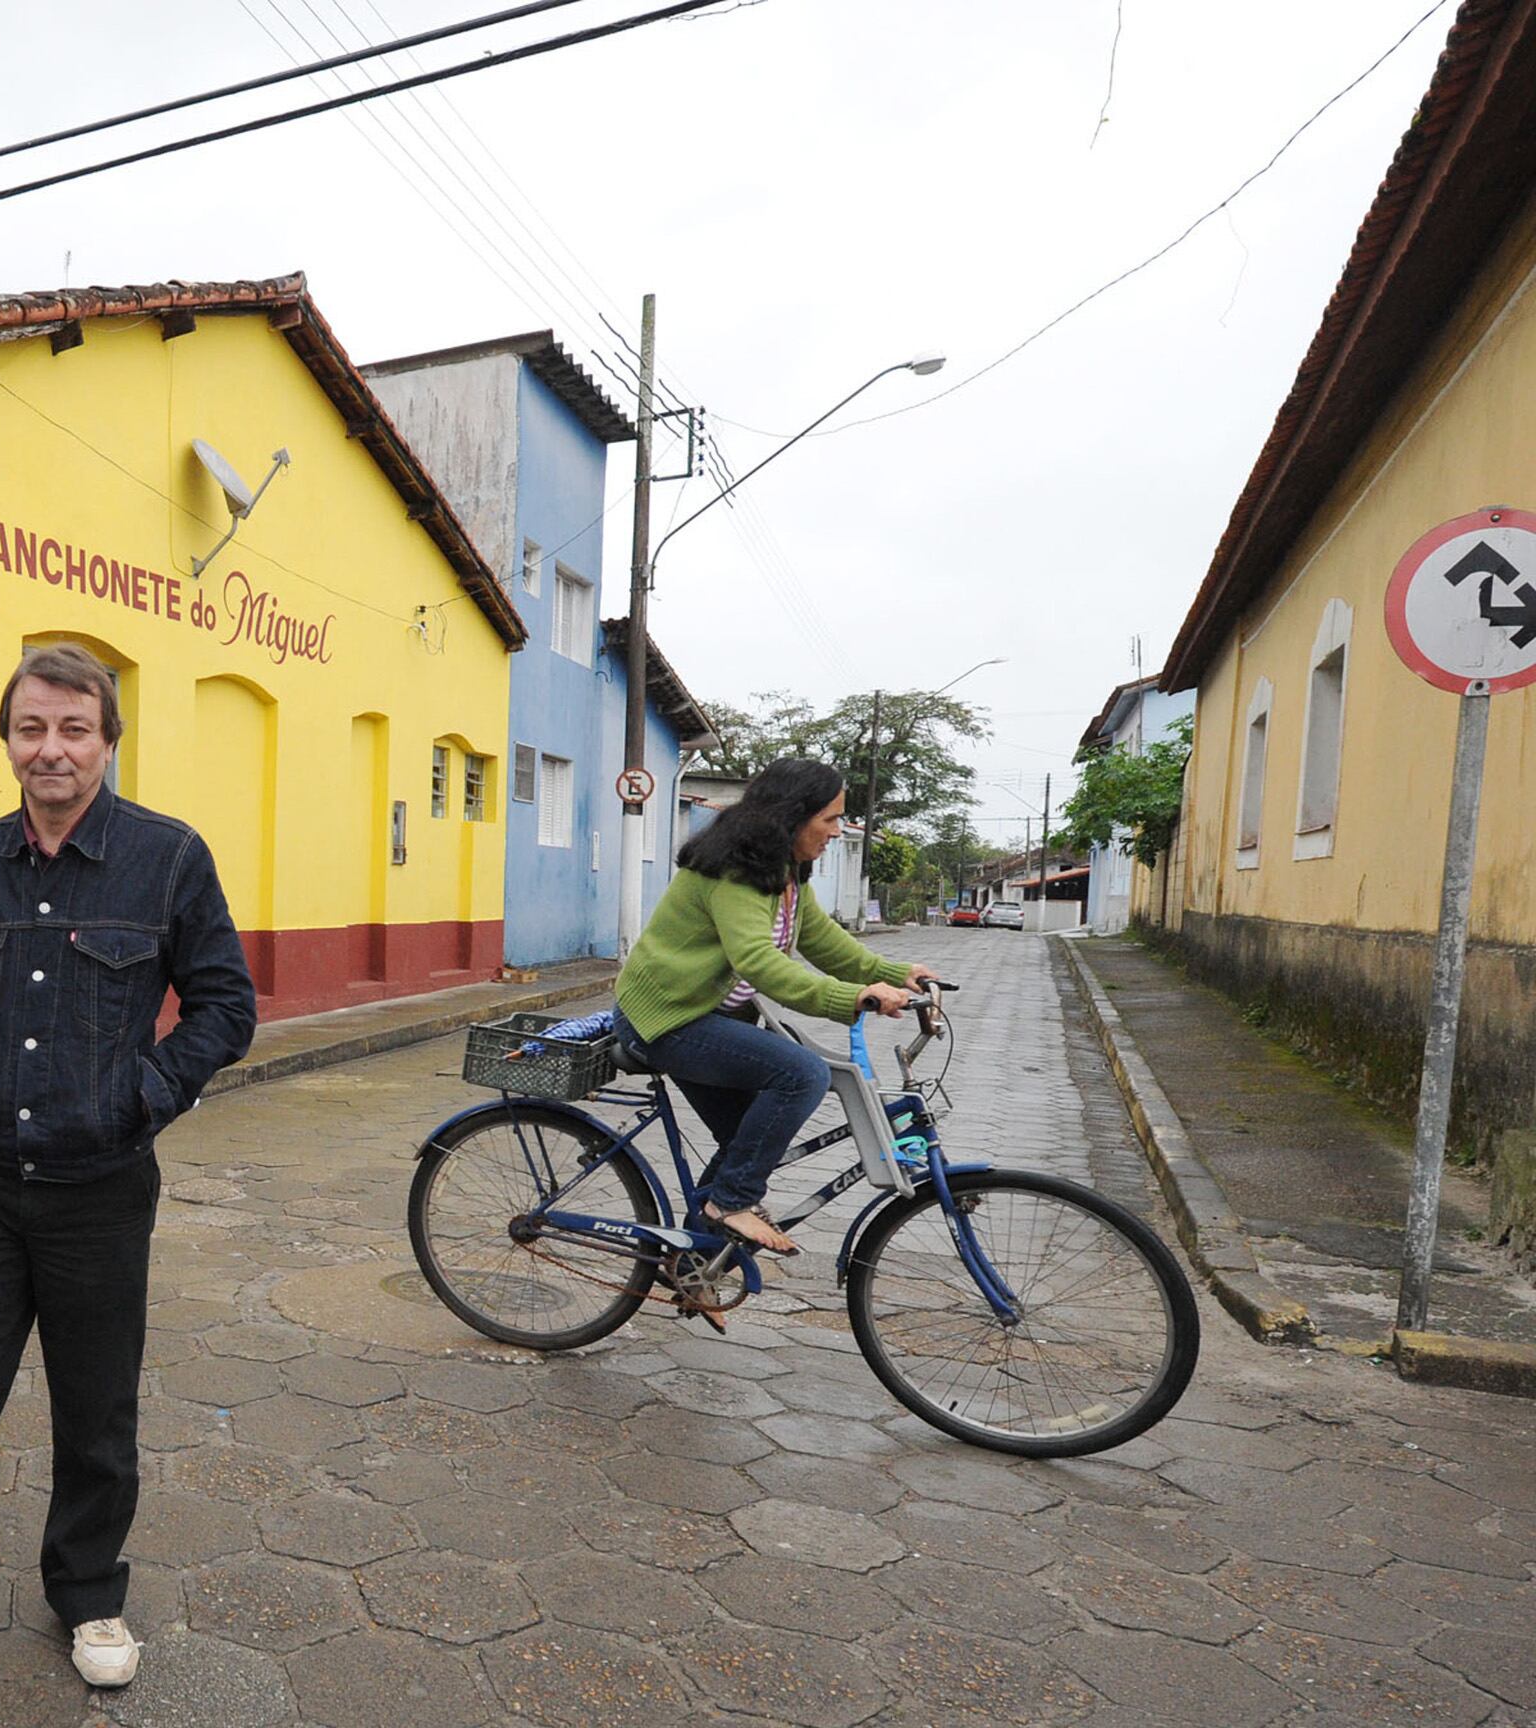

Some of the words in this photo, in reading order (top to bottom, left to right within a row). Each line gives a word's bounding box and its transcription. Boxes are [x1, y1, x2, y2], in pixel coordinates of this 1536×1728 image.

[190, 590, 216, 631] do
[221, 571, 337, 665] Miguel
[832, 1168, 865, 1193] CAL
[593, 1221, 633, 1236] Poti
